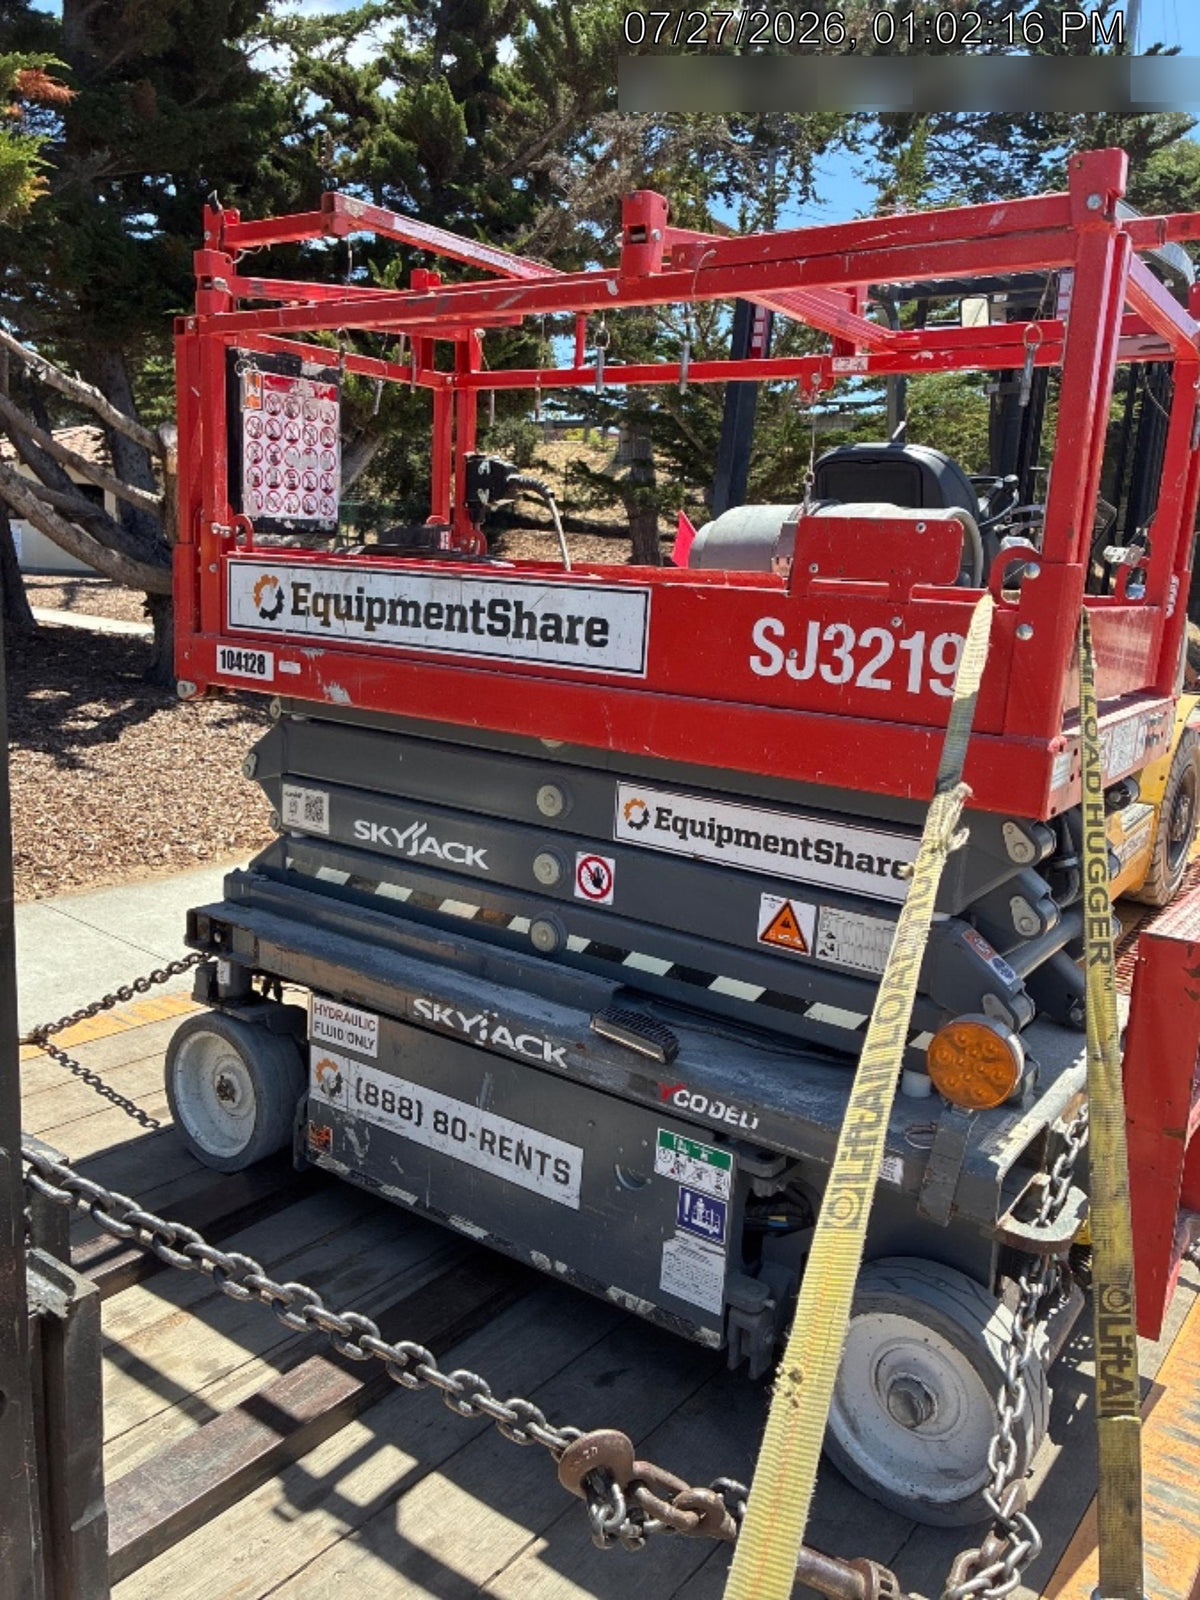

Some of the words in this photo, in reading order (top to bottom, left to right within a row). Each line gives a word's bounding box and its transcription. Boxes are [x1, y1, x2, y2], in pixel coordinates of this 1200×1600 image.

[290, 581, 610, 648] EquipmentShare
[219, 648, 266, 675] 104128
[749, 616, 967, 697] SJ3219
[1083, 696, 1102, 794] LOAD
[353, 819, 490, 871] SKYJACK
[653, 806, 911, 880] EquipmentShare
[313, 1002, 377, 1033] HYDRAULIC
[313, 1021, 344, 1042] FLUID
[347, 1031, 376, 1050] ONLY
[355, 1076, 424, 1128] (888)
[432, 1109, 572, 1186] 80-RENTS
